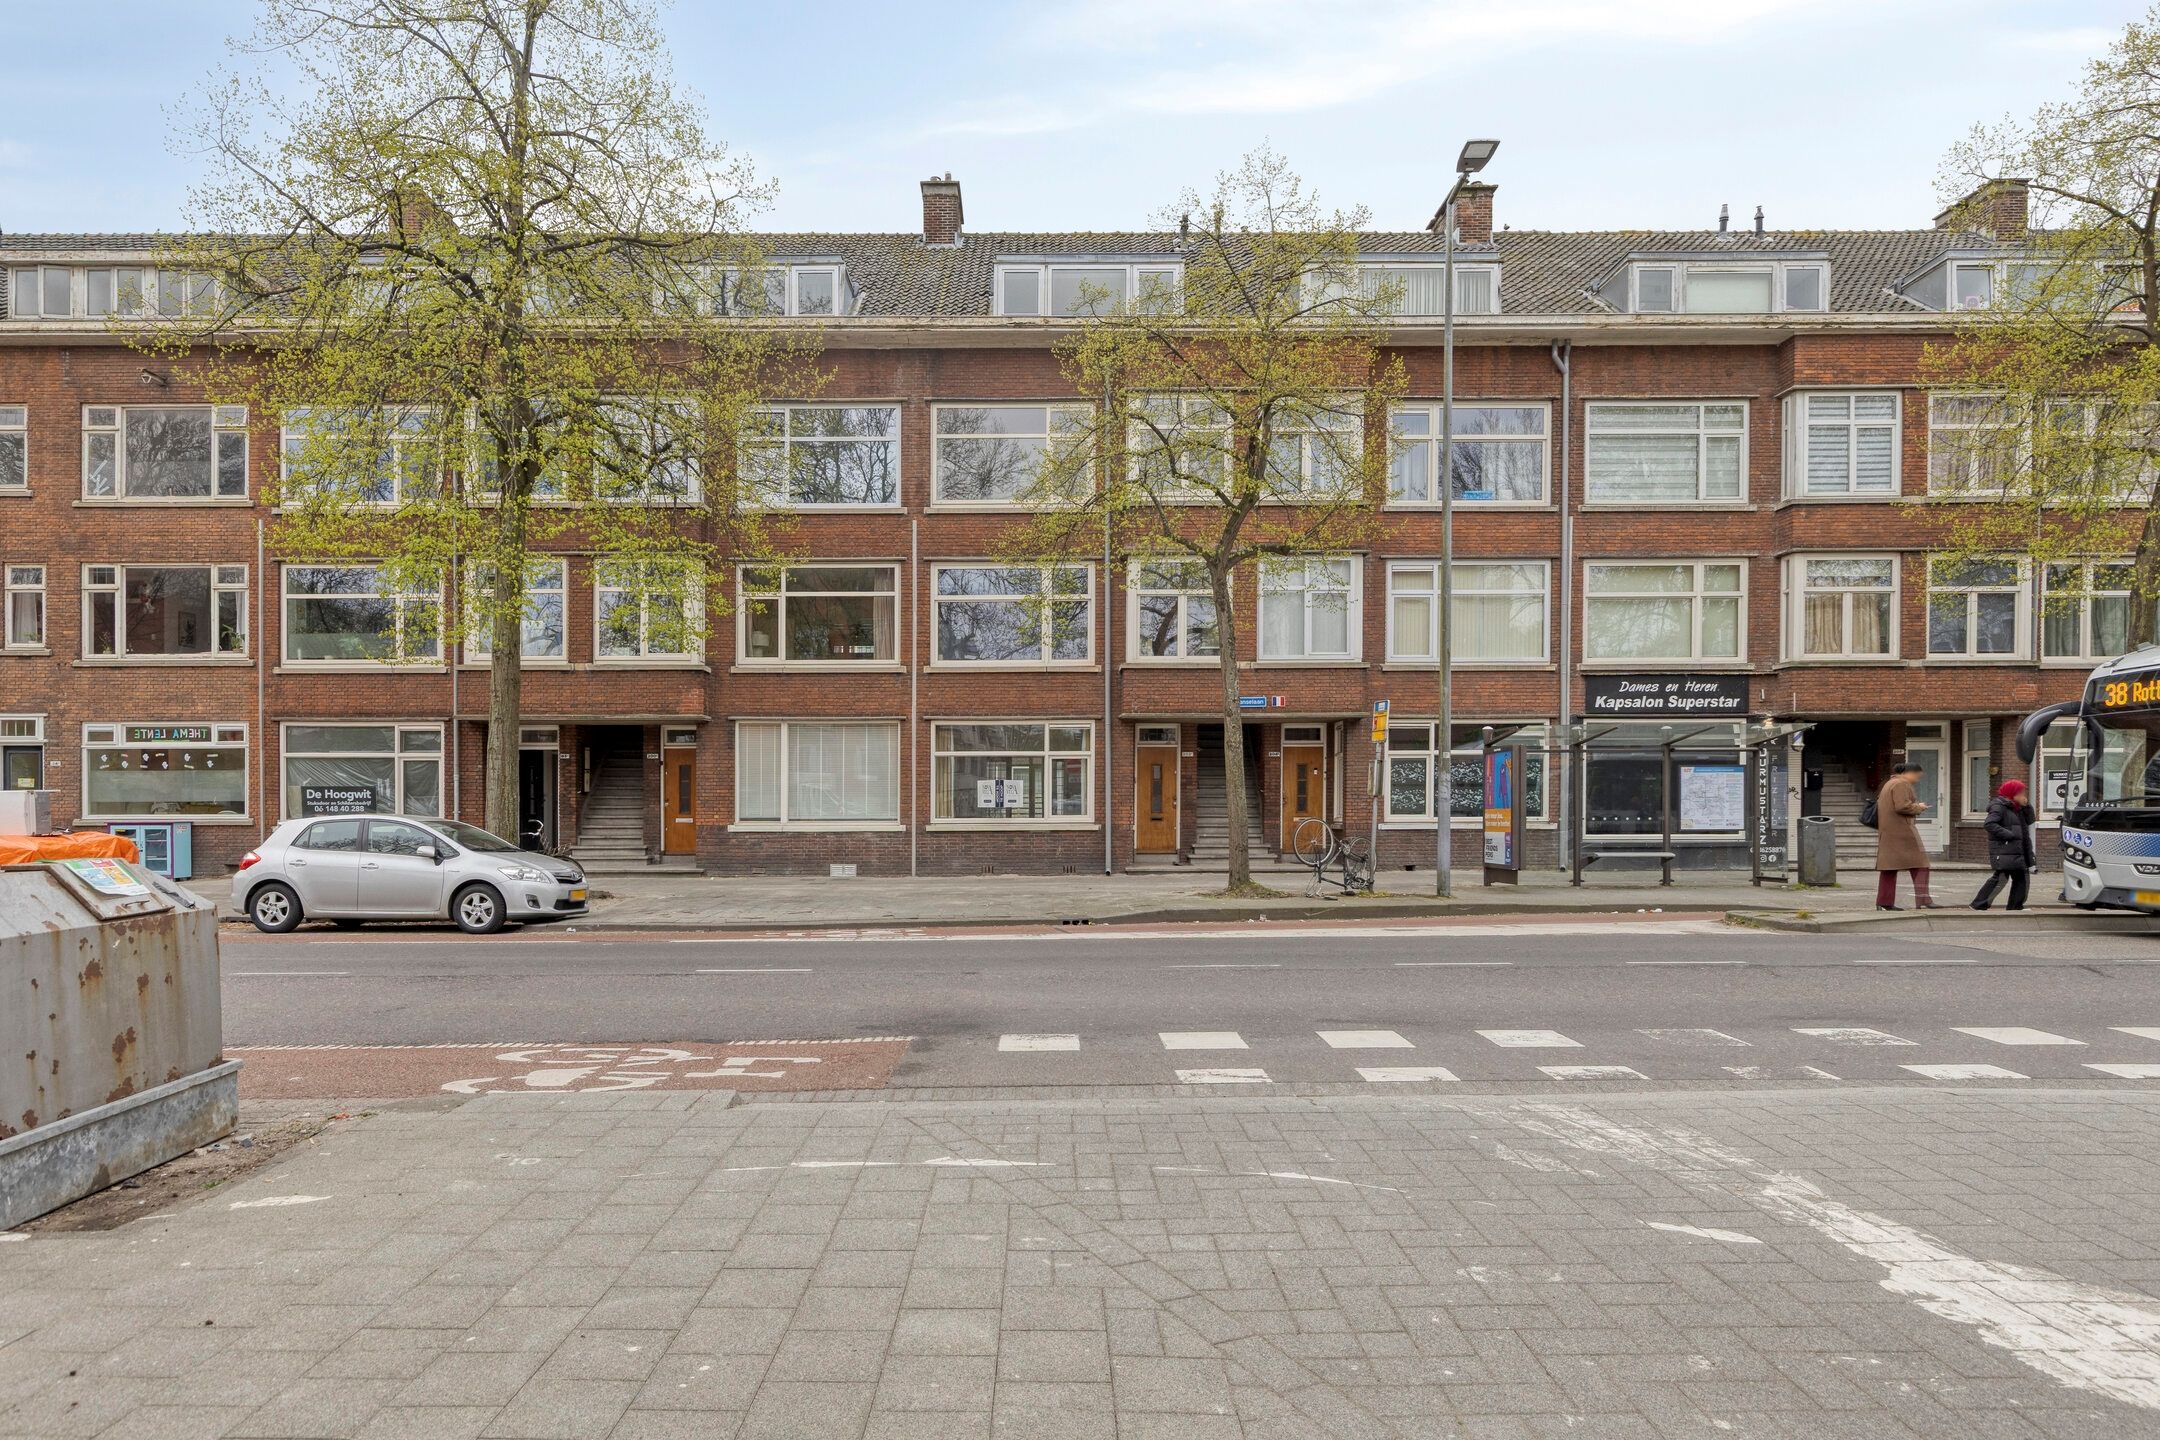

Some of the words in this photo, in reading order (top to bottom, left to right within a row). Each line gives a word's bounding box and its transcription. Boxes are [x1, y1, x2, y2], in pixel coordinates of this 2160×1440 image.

[1619, 681, 1659, 692] Dames
[1665, 683, 1678, 692] en
[1684, 681, 1718, 692] Heren
[2105, 682, 2128, 706] 38
[1595, 696, 1664, 710] Kapsalon
[1667, 696, 1740, 710] Superstar
[306, 789, 322, 799] De
[324, 789, 372, 801] Hoogwit
[2137, 864, 2160, 873] VDL
